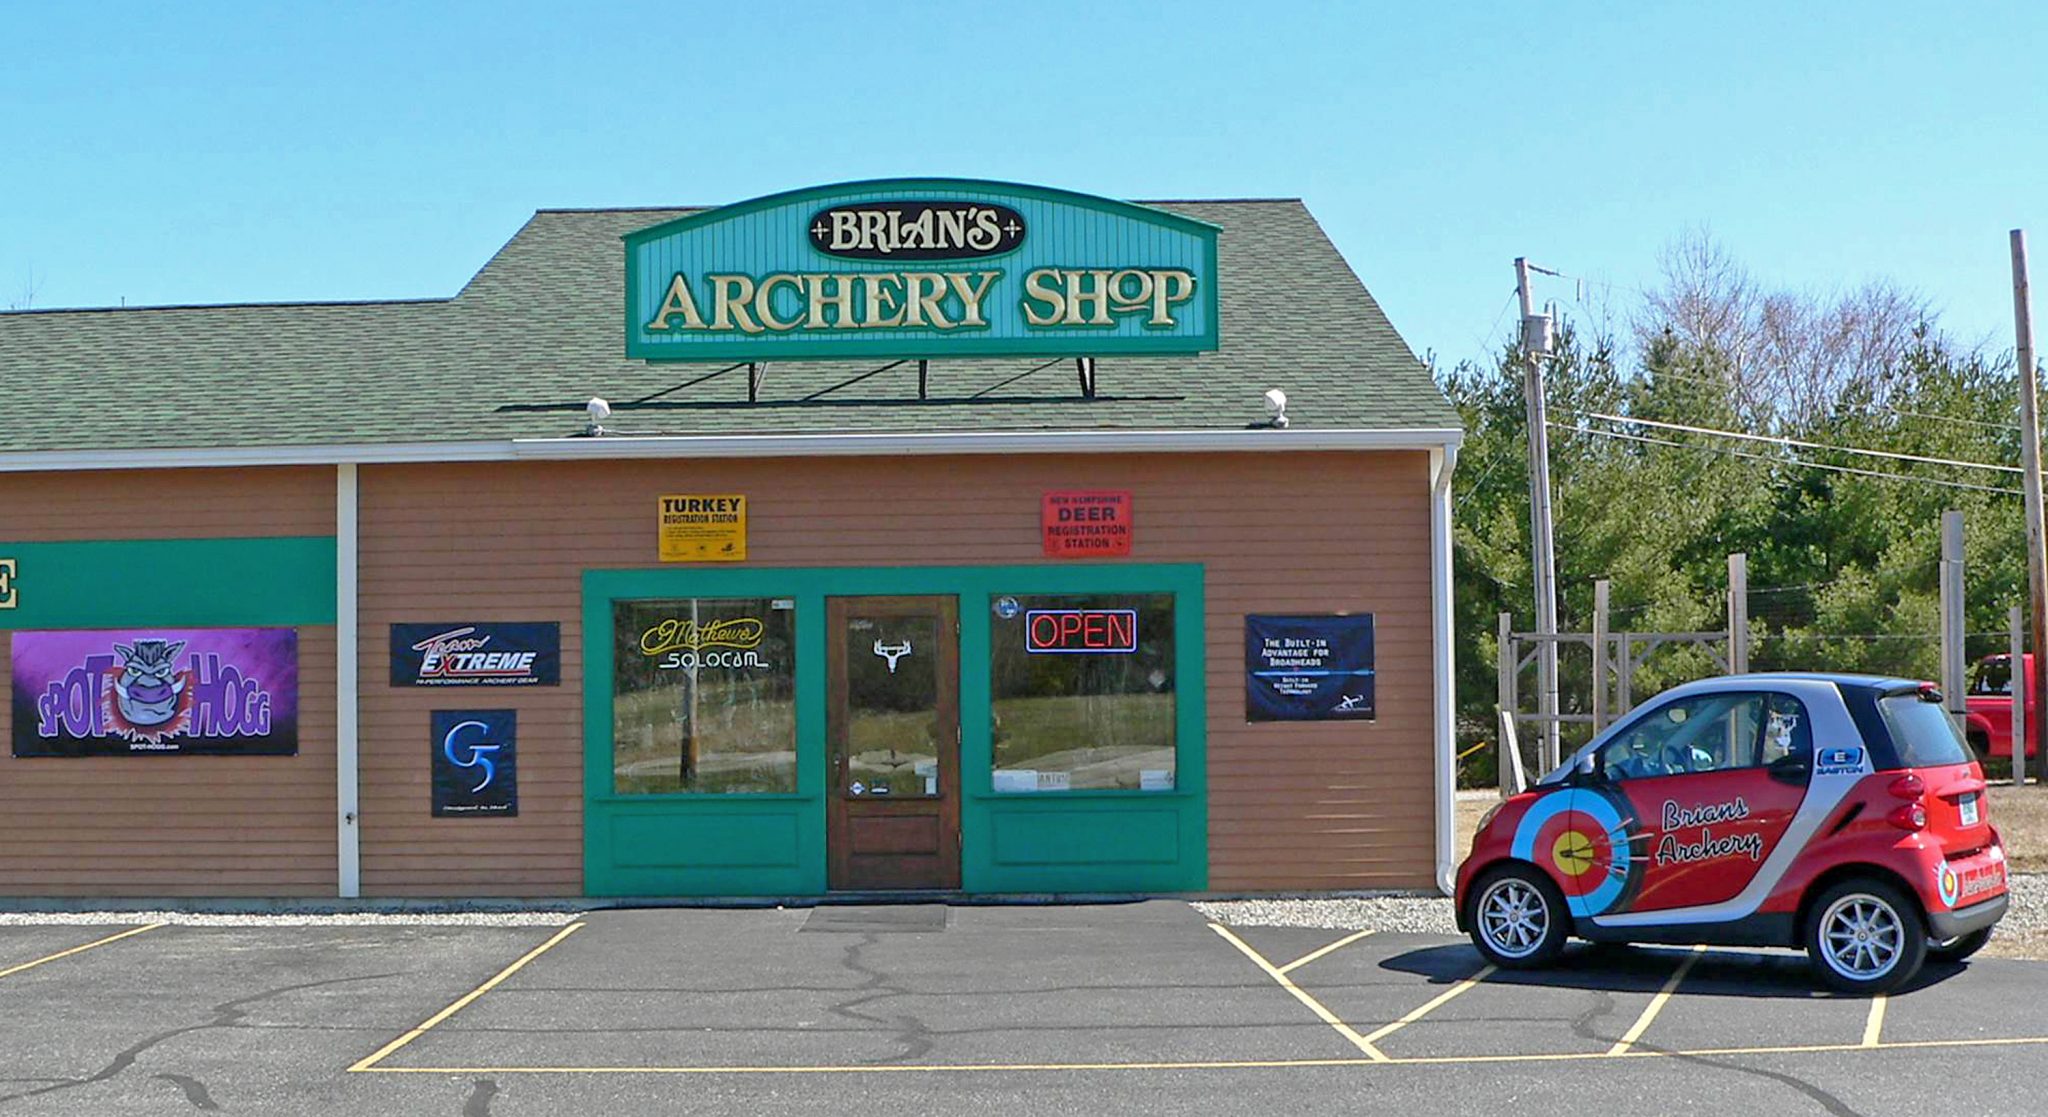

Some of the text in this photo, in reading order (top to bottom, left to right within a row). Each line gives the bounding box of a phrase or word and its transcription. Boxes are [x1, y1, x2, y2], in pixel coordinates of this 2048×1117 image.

[830, 207, 1002, 254] BRIAN'S
[648, 267, 1197, 332] ARCHERY SHOP
[663, 498, 741, 513] TURKEY
[663, 513, 738, 524] REGISTRATION STATION
[1058, 507, 1115, 521] DEER
[1048, 525, 1126, 536] REGISTRATION
[1064, 538, 1110, 549] STATION
[412, 627, 491, 659] Team
[640, 618, 763, 655] Mathews
[1031, 614, 1132, 648] OPEN
[659, 651, 769, 668] SOLOCAM
[38, 654, 271, 738] SPOT HOGG
[1816, 766, 1863, 775] EASTON
[1662, 797, 1750, 832] Brians
[1655, 827, 1763, 866] Archery
